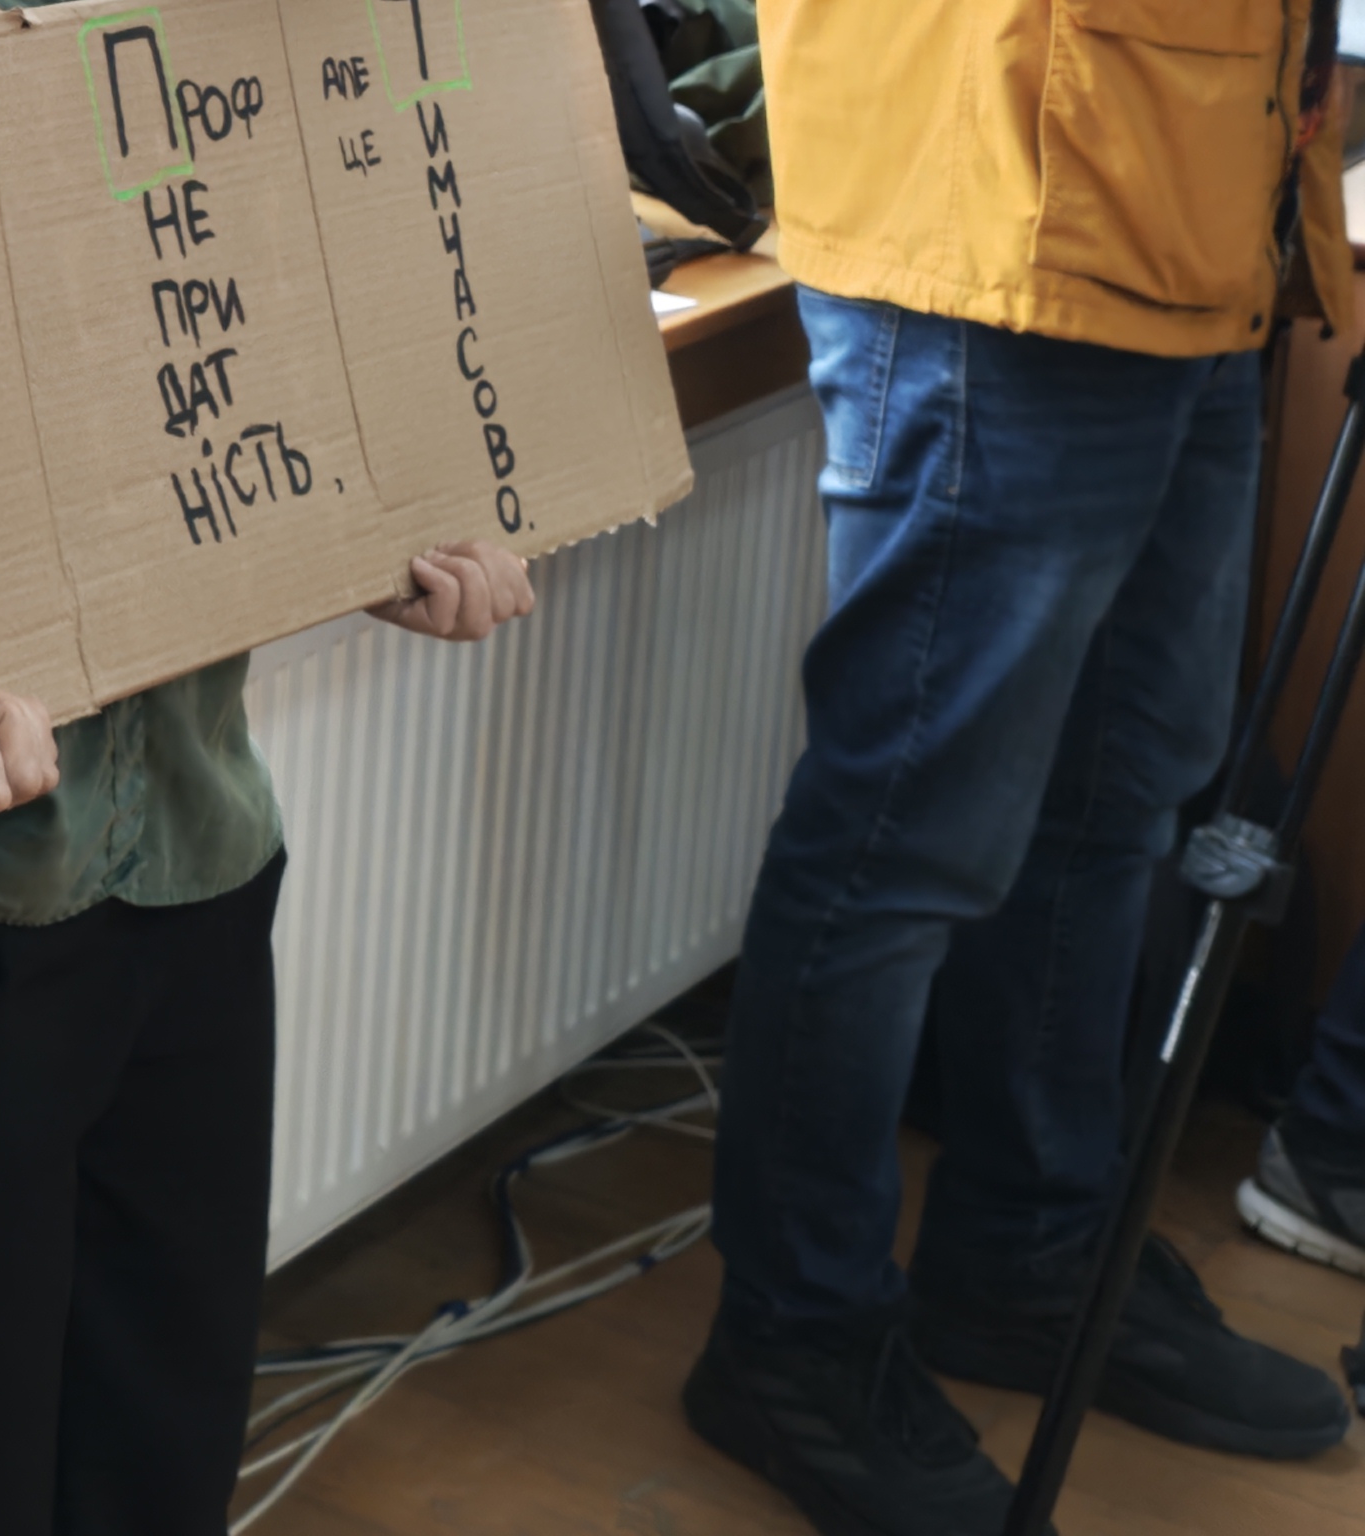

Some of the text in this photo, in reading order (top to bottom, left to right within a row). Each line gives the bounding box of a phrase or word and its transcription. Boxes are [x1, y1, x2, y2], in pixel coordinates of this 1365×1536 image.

[322, 57, 370, 101] АЛЕ
[339, 130, 381, 176] ЦЕ
[144, 180, 215, 259] НЕ
[152, 277, 245, 348] ПРИ
[157, 348, 238, 438] ДАТ
